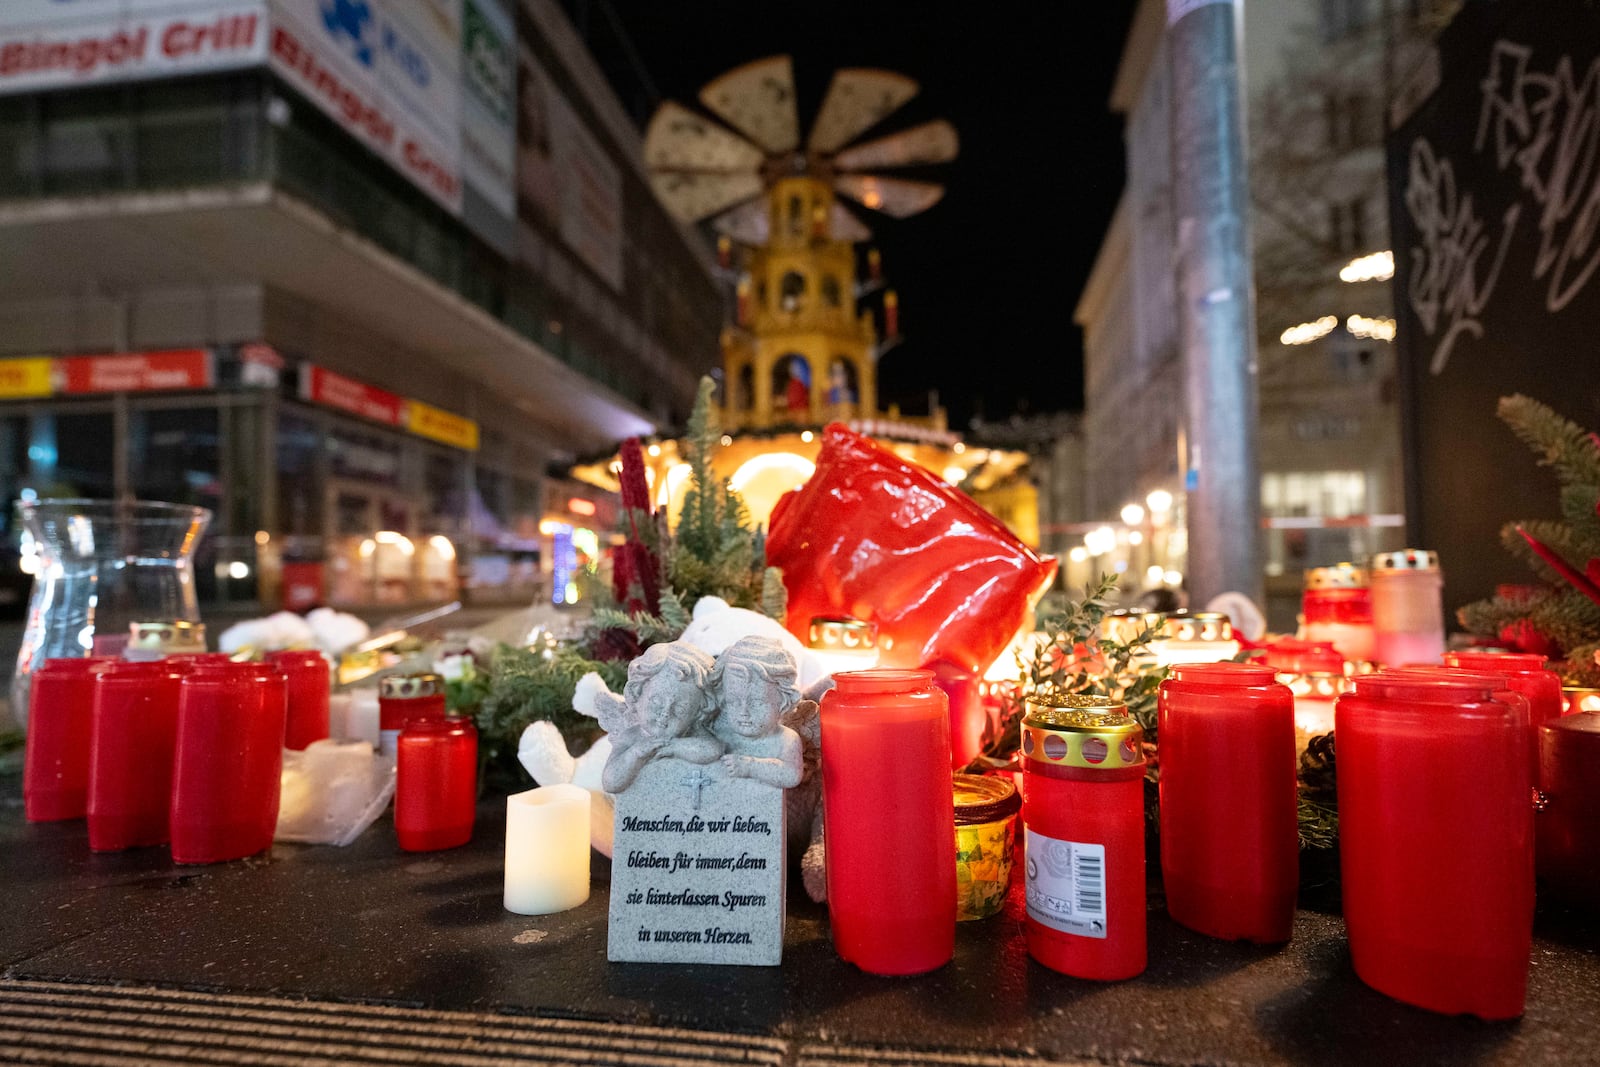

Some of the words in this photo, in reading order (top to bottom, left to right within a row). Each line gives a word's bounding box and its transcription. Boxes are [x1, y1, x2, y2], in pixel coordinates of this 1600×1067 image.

[707, 816, 731, 833] wir
[732, 815, 771, 836] lieben,
[627, 851, 670, 869] bleiben
[669, 851, 694, 874] für
[626, 888, 643, 905] sie
[645, 888, 720, 907] hinterlassen
[721, 890, 767, 912] Spuren
[638, 925, 651, 942] in
[654, 930, 701, 943] unseren
[703, 927, 753, 944] Herzen.
